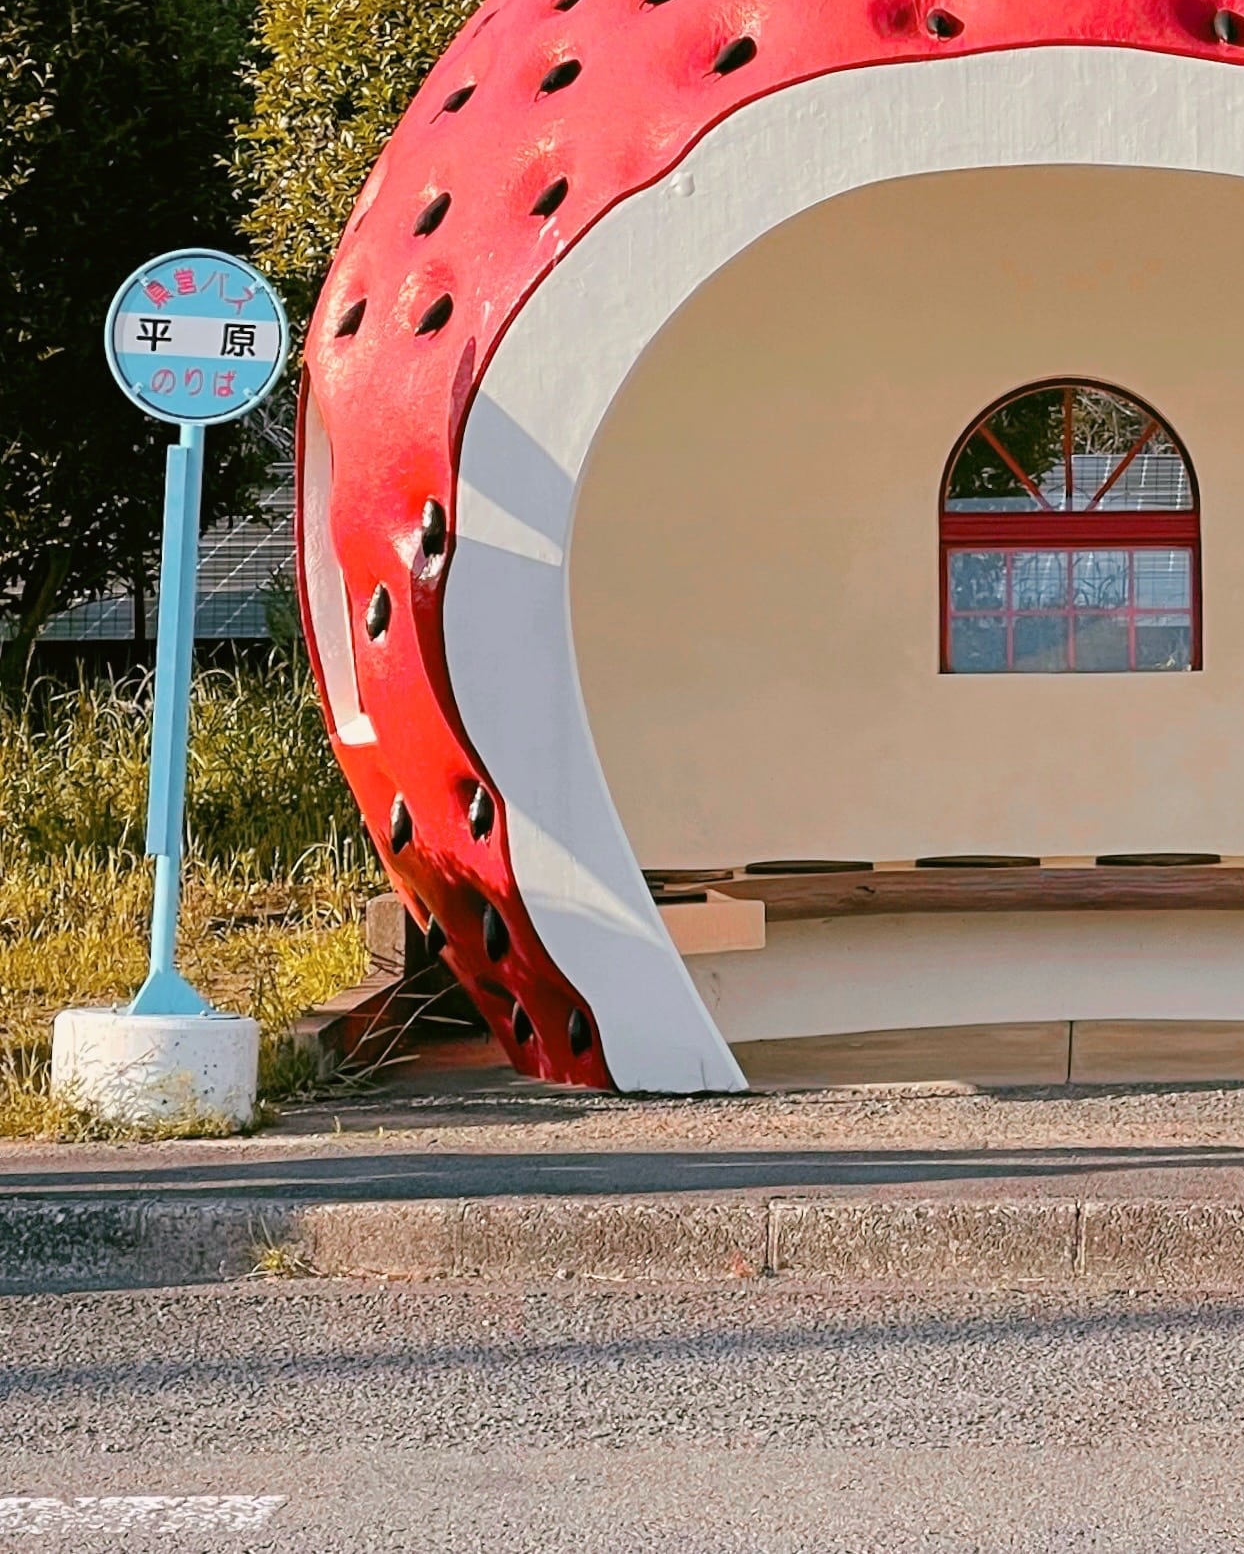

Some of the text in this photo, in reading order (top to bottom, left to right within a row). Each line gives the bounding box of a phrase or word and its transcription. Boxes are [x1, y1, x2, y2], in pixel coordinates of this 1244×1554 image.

[136, 318, 256, 357] 平原
[151, 368, 236, 397] のりば
